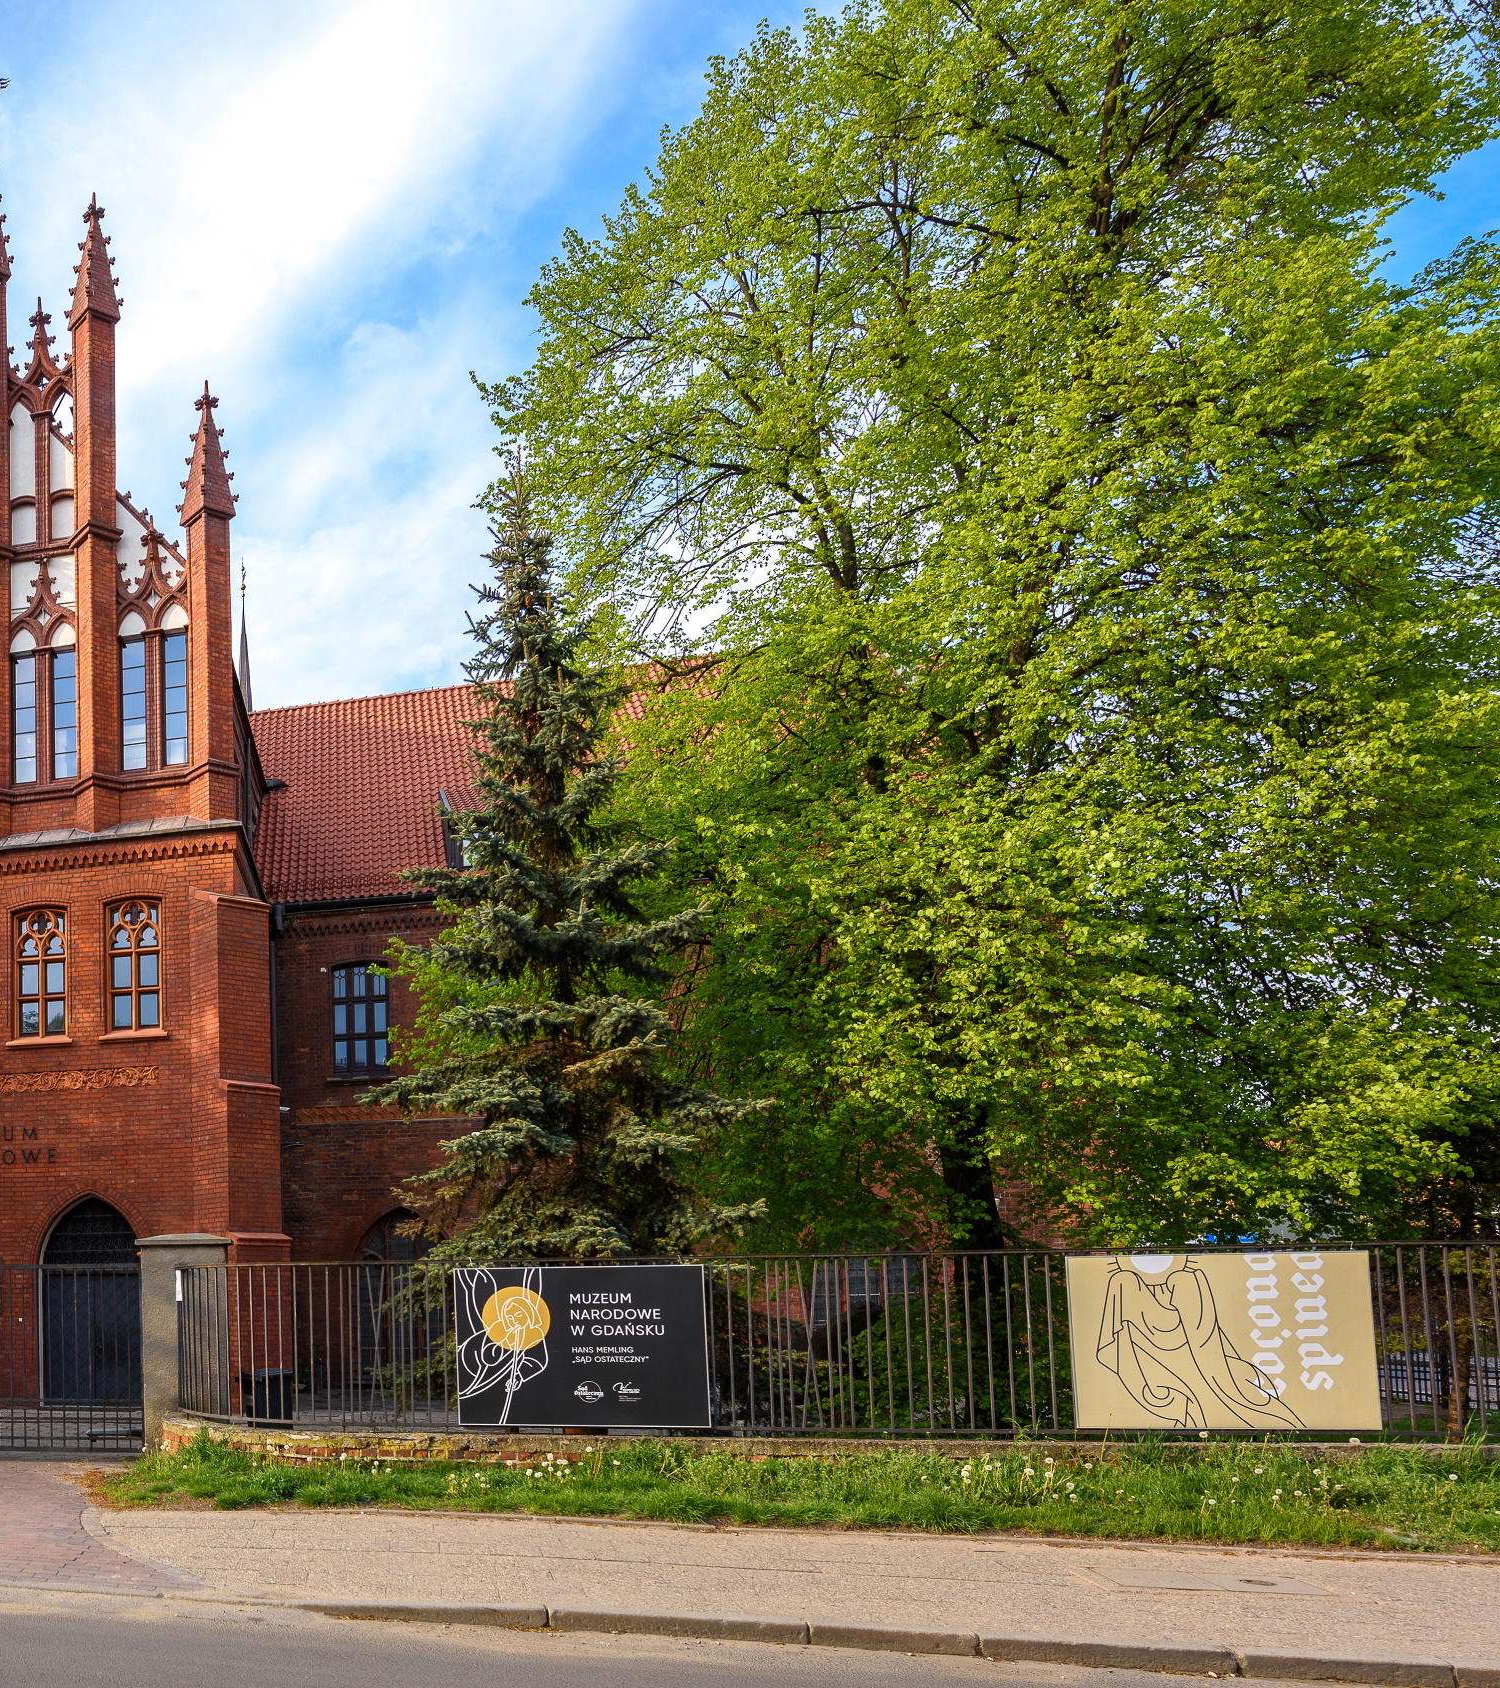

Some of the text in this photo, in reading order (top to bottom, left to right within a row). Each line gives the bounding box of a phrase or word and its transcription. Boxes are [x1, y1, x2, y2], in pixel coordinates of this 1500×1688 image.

[569, 1293, 632, 1304] MUZEUM
[570, 1308, 661, 1320] NARODOWE
[571, 1322, 665, 1336] W GDAŃSKU
[572, 1346, 634, 1354] HANS MEMLING
